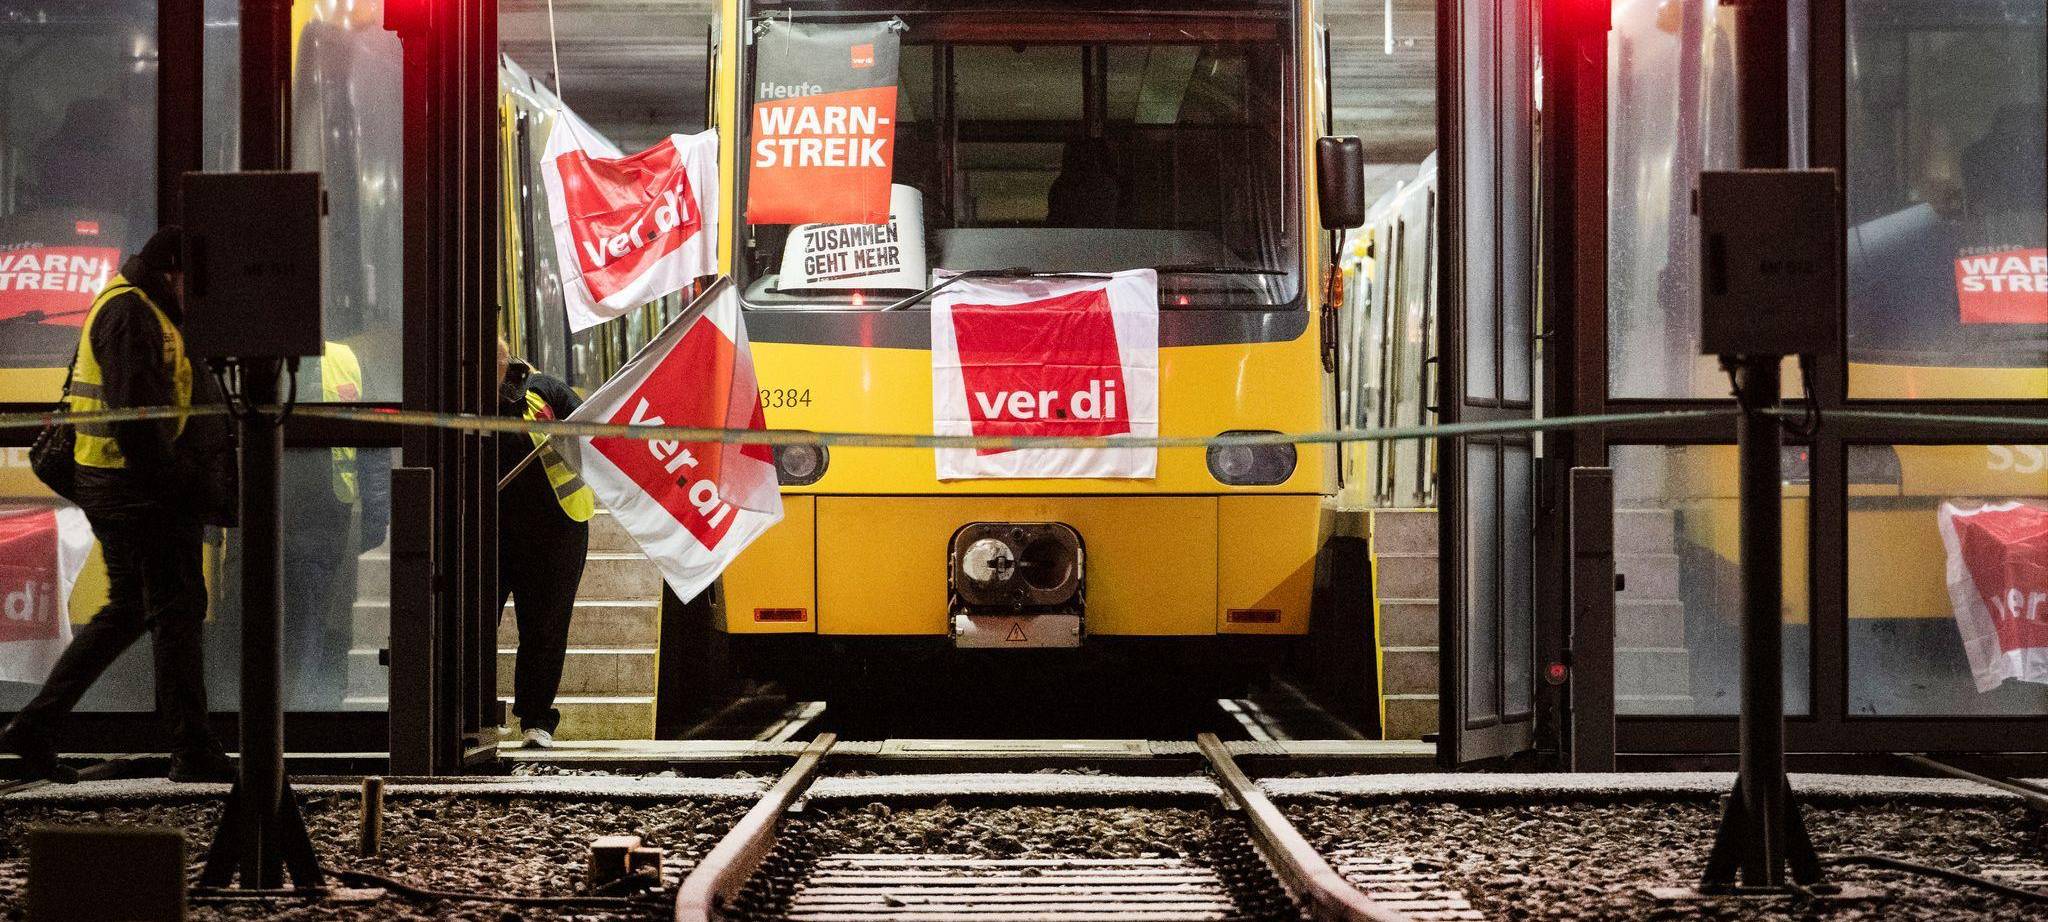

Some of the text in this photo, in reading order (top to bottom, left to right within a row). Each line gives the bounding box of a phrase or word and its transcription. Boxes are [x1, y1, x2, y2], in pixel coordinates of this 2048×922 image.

[760, 82, 823, 99] Heute
[759, 106, 890, 136] WARN-
[755, 138, 887, 168] STREIK
[582, 184, 690, 268] ver.di
[804, 222, 898, 253] ZUSAMMEN
[804, 246, 900, 276] GEHT MEHR
[760, 388, 812, 409] 3384
[975, 379, 1116, 420] ver.di
